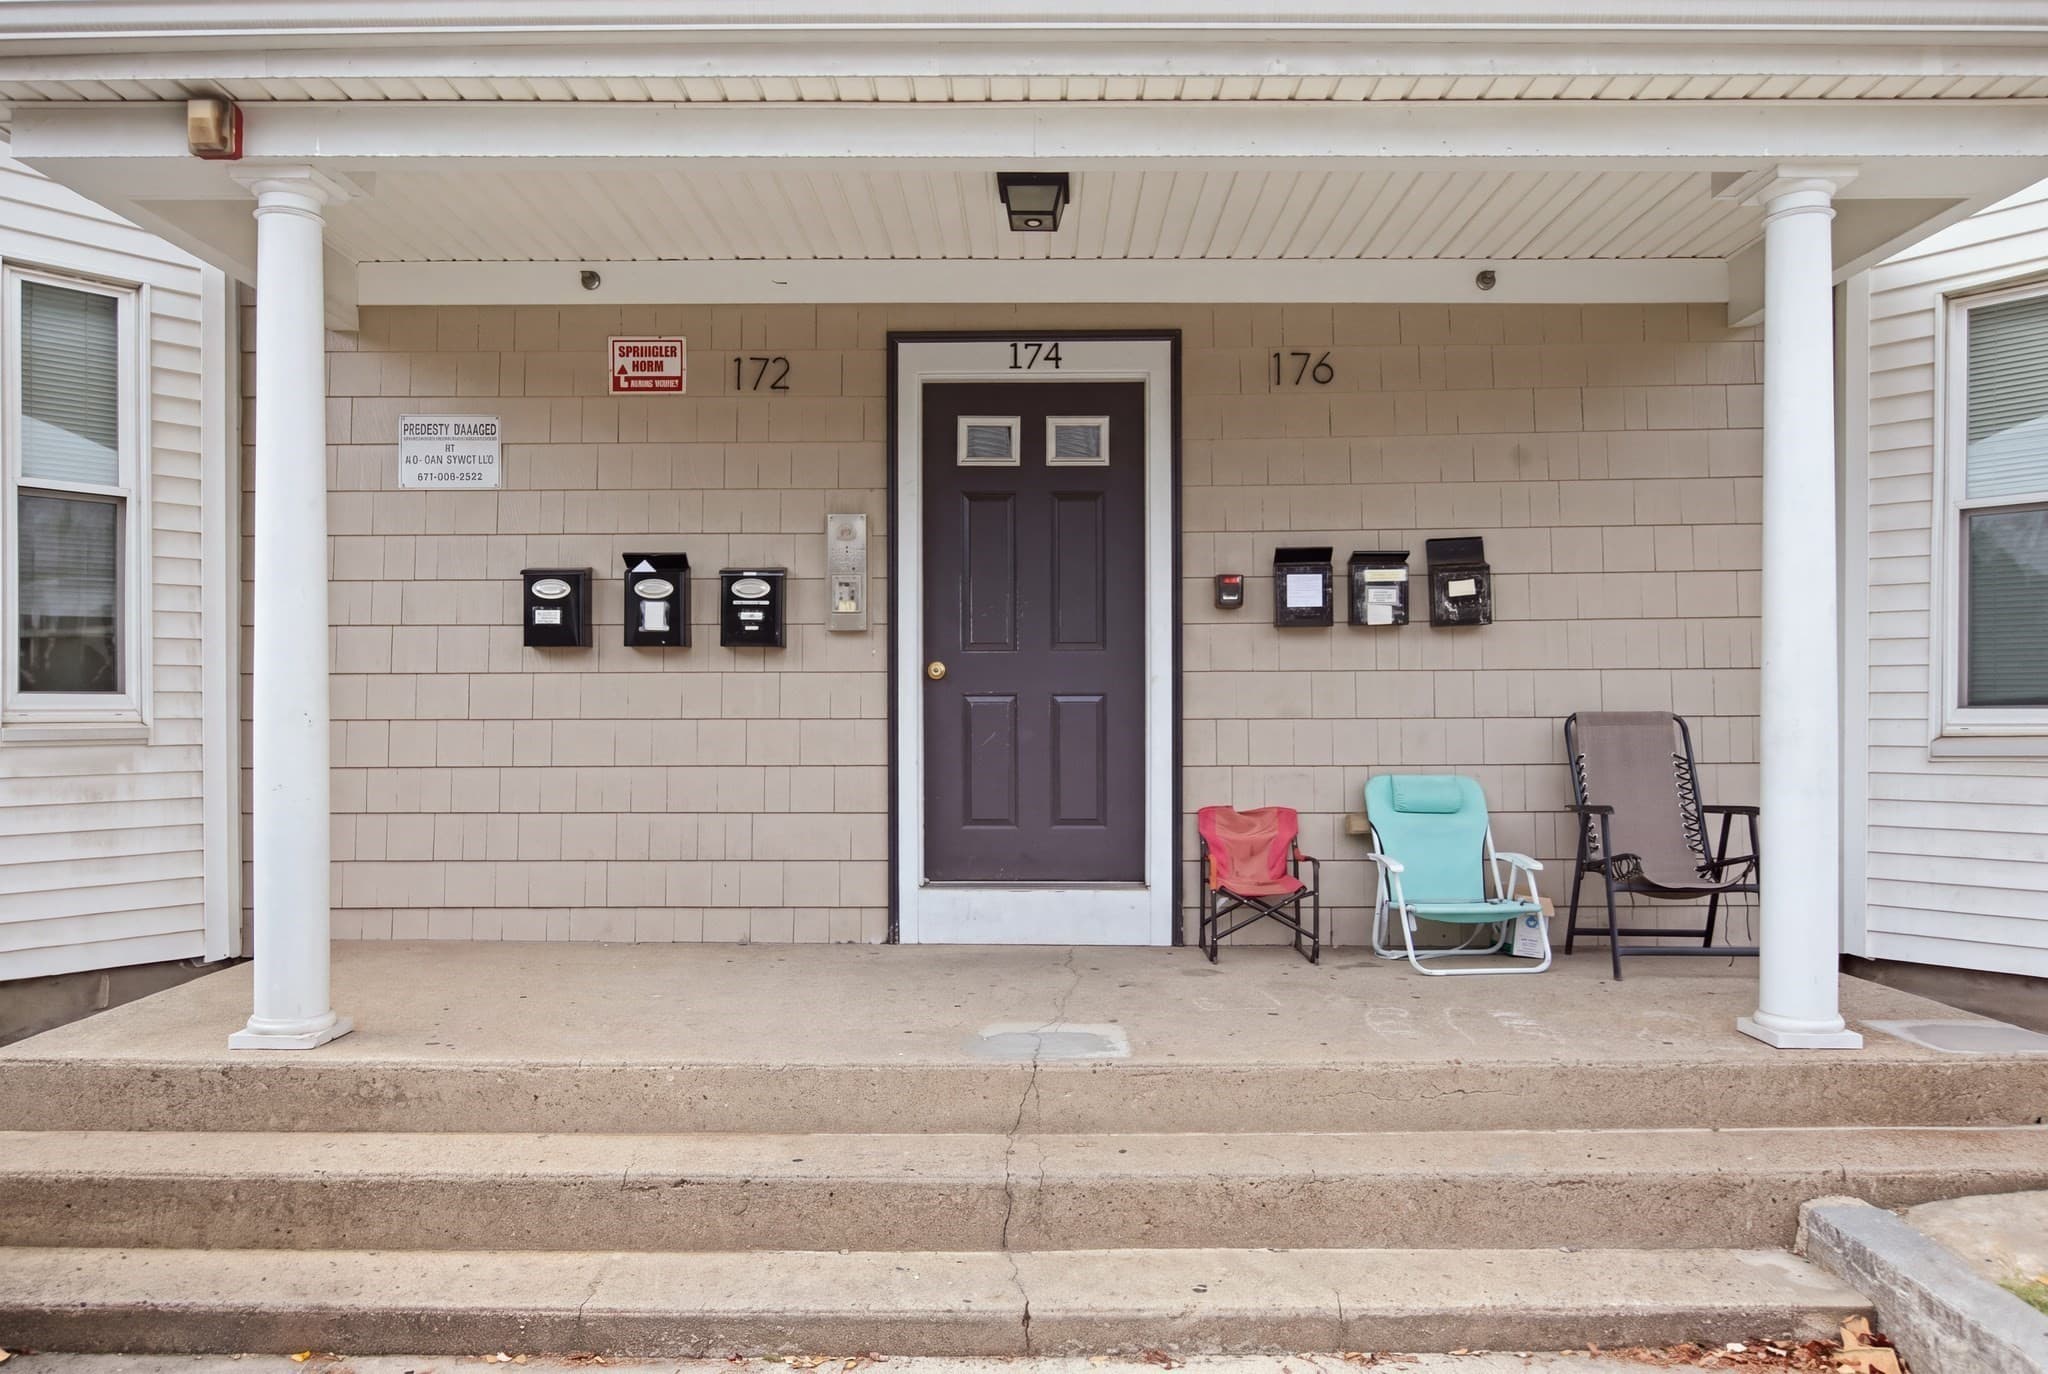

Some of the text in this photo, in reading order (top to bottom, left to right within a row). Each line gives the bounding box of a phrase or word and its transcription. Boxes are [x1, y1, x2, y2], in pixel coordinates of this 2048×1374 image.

[1009, 342, 1062, 370] 174
[1272, 351, 1334, 386] 176
[733, 357, 790, 391] 172
